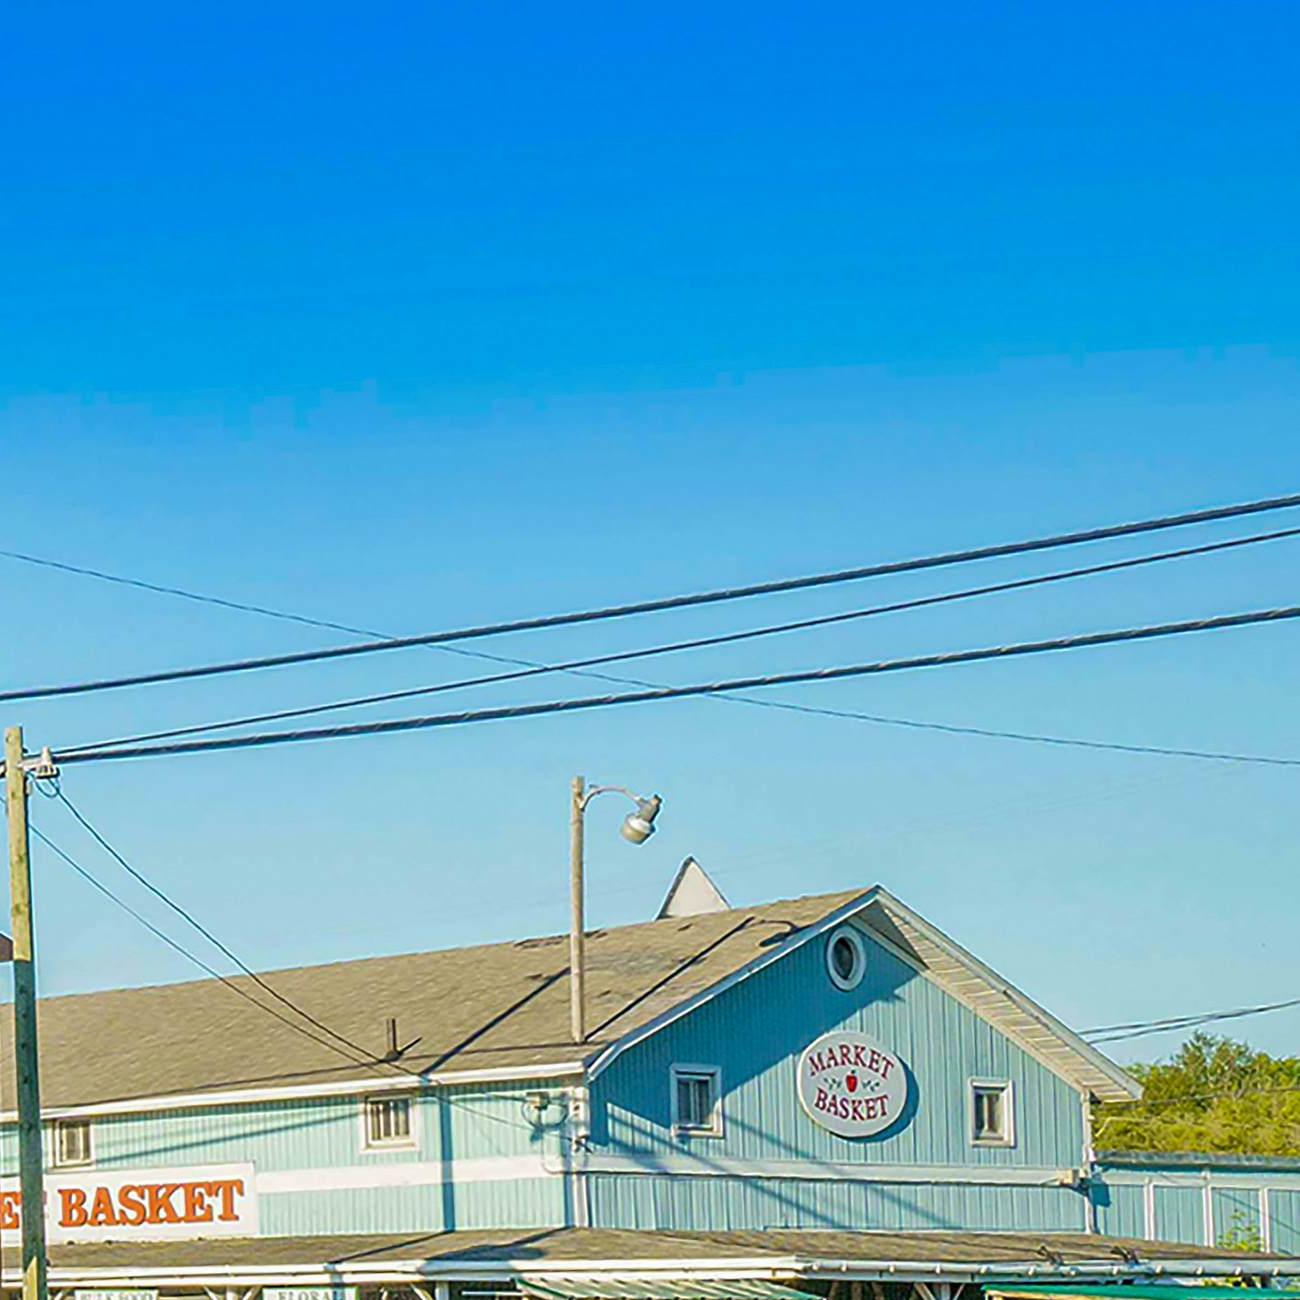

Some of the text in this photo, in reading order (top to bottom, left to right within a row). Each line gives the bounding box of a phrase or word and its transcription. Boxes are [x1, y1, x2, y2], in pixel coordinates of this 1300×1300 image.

[809, 1044, 894, 1079] MARKET
[815, 1087, 888, 1121] BASKET
[58, 1179, 244, 1227] BASKET
